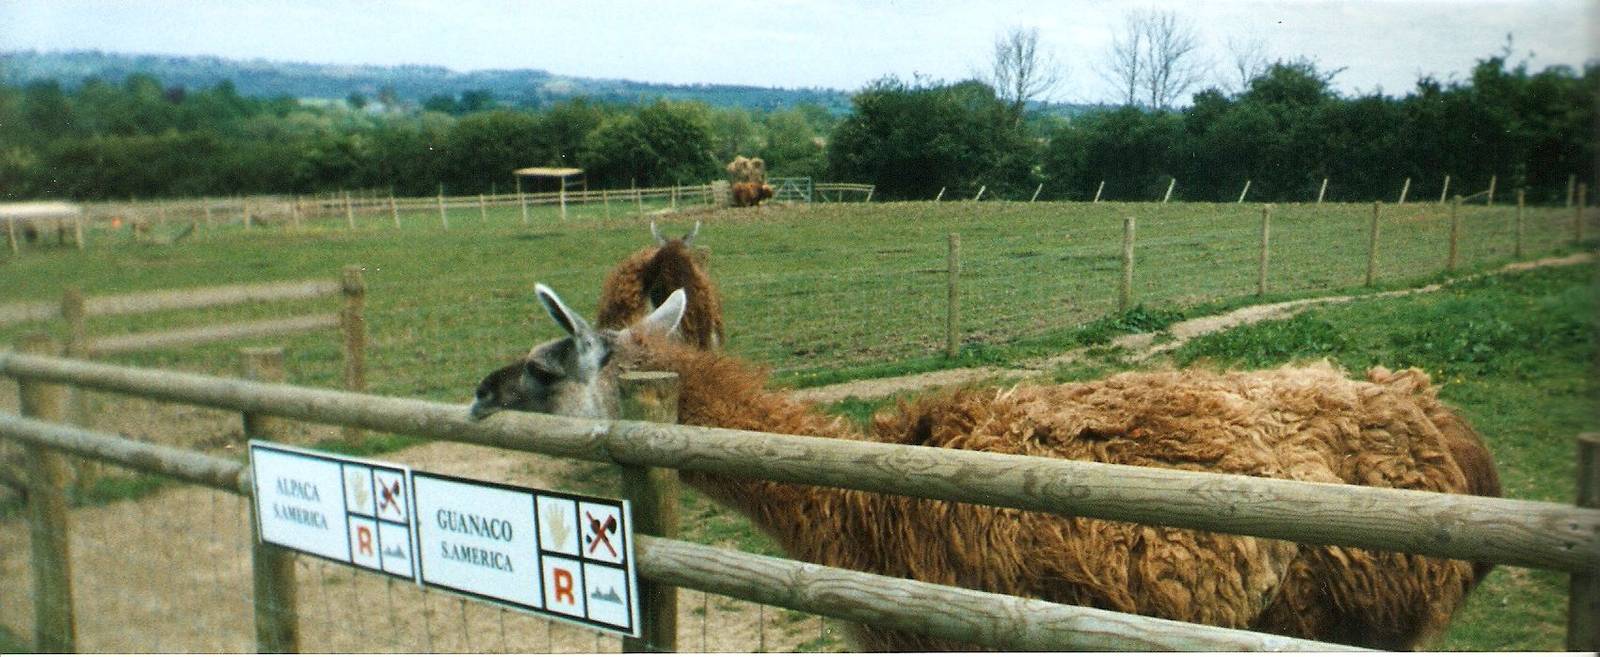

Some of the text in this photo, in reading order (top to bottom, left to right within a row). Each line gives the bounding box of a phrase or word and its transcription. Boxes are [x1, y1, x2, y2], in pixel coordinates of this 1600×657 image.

[276, 476, 320, 502] ALPACA
[273, 503, 328, 530] S.AMERICA
[436, 509, 513, 542] GUANACO
[357, 526, 373, 557] R
[440, 540, 514, 572] S.AMERICA
[553, 567, 575, 605] R
